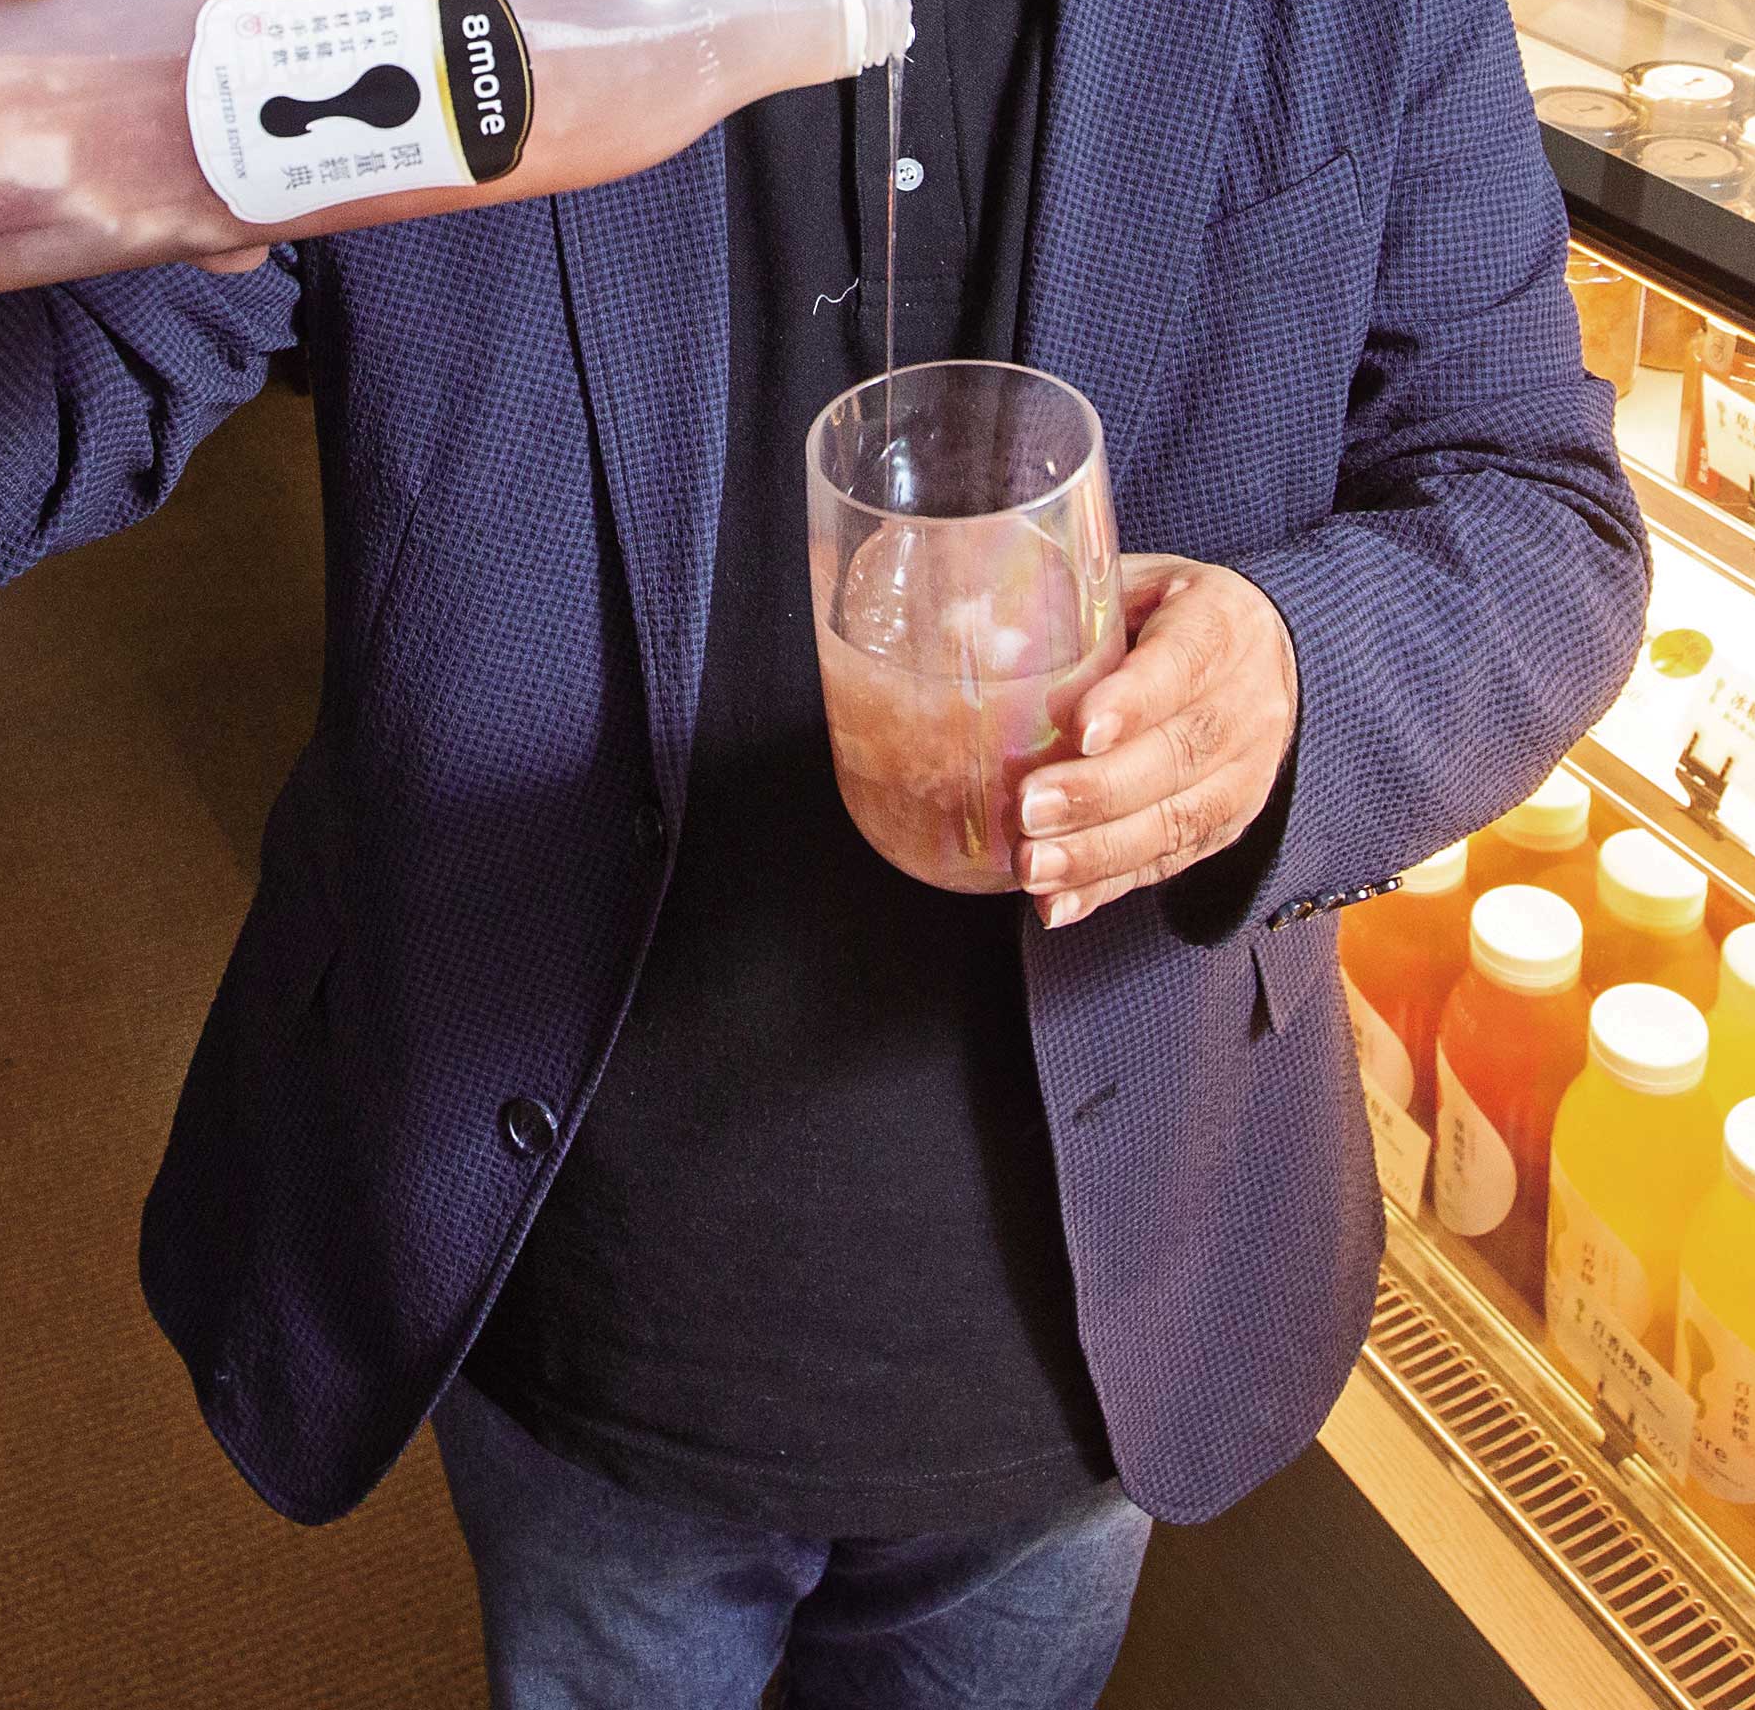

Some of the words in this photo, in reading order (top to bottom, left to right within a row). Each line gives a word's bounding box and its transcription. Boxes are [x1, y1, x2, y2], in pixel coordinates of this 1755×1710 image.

[214, 66, 239, 125] LIMITED
[461, 13, 507, 137] 8more
[226, 126, 248, 181] EDITION
[281, 142, 423, 191] 限量經典
